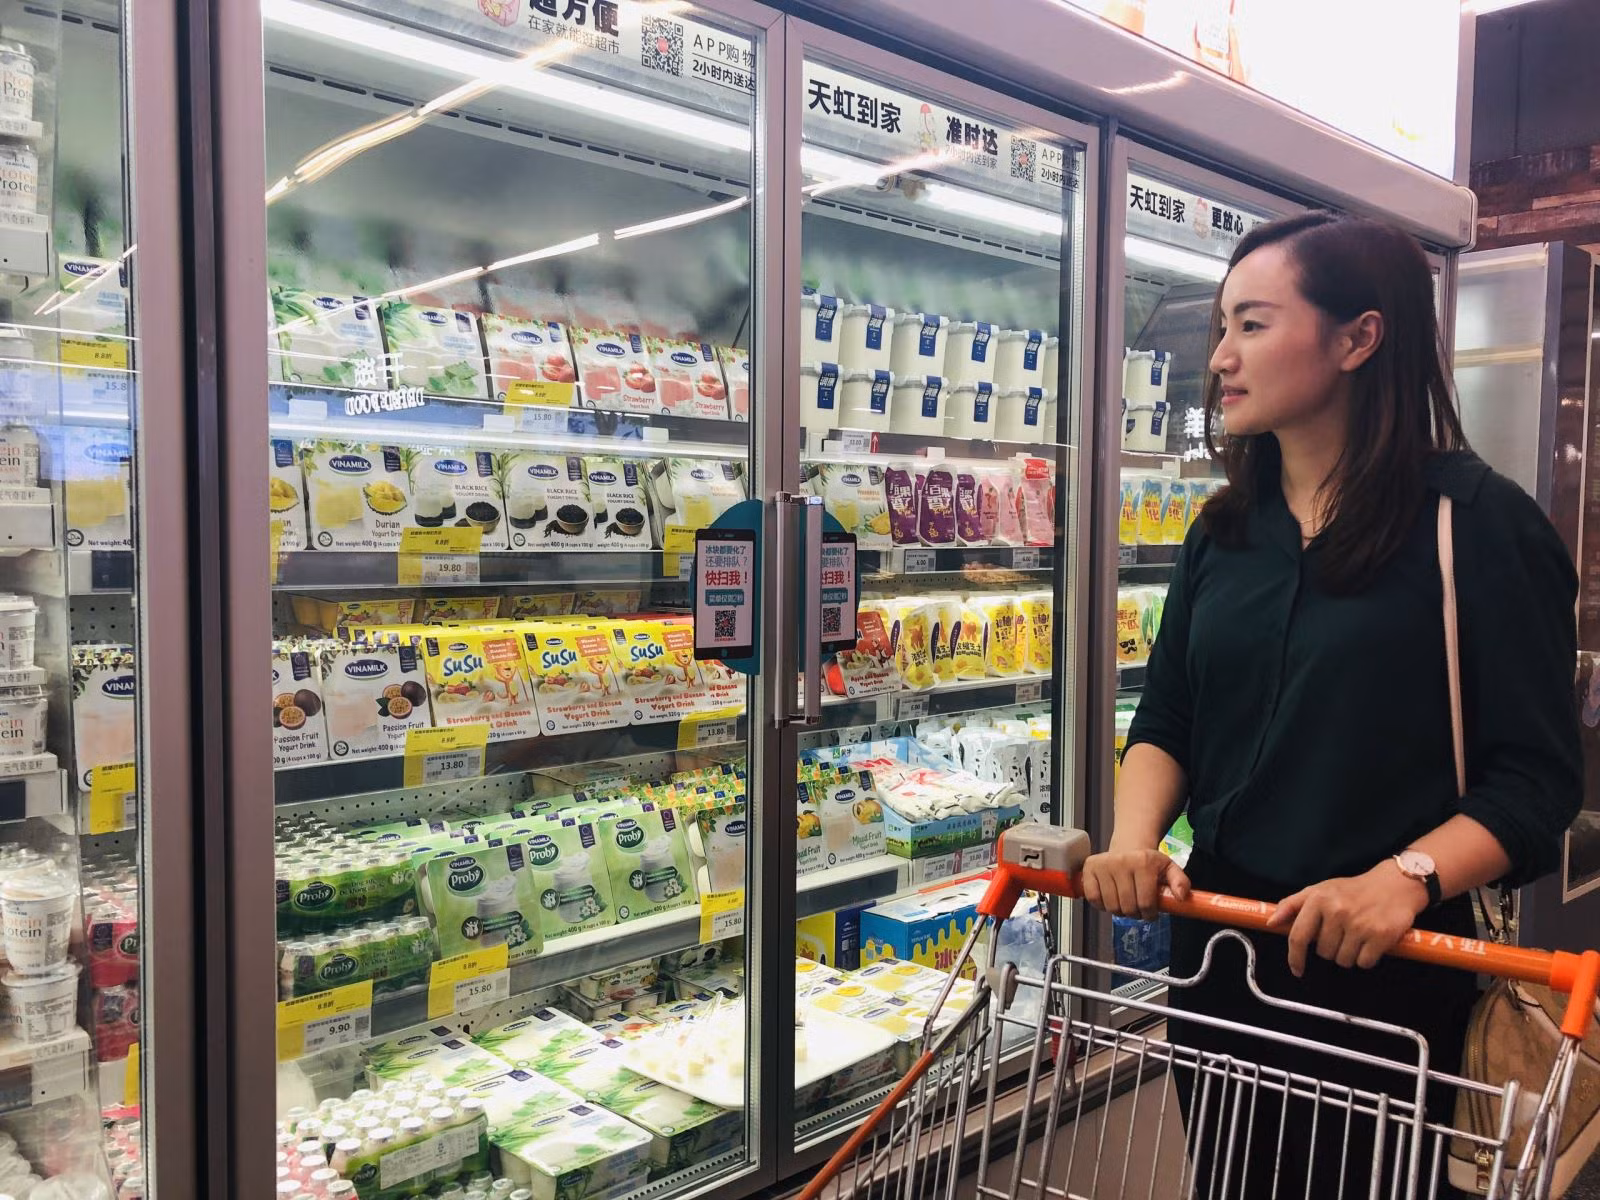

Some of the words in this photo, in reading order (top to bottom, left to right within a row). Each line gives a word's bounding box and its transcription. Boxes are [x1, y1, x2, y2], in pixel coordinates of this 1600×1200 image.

[692, 59, 757, 91] 2小时内送达
[808, 78, 901, 133] 天虹到家
[946, 115, 998, 156] 准时达
[1129, 184, 1185, 224] 天虹到家
[1211, 206, 1244, 236] 更放心
[511, 331, 542, 345] VINAMILK
[597, 345, 625, 356] VINAMILK
[672, 354, 697, 365] VINAMILK
[623, 393, 655, 405] Strawberry
[695, 400, 725, 411] Strawberry
[534, 413, 552, 421] 15.80
[331, 459, 370, 470] VINAMILK
[435, 462, 467, 473] VINAMILK
[529, 467, 558, 478] VINAMILK
[590, 473, 617, 483] VINAMILK
[375, 519, 400, 529] Durian
[372, 530, 389, 538] Yogurt
[705, 545, 747, 555] 冰块都要化了
[439, 563, 462, 572] 19.80
[704, 569, 748, 586] 快扫我！
[542, 648, 577, 669] SuSu
[630, 643, 664, 662] SuSu
[346, 663, 386, 674] VINAMILK
[443, 654, 483, 677] SuSu
[634, 695, 672, 705] Strawberry
[684, 691, 706, 699] Banana
[546, 703, 586, 714] Strawberry
[598, 700, 622, 708] Banana
[651, 702, 675, 712] Yogurt
[446, 714, 490, 725] Strawberry
[504, 709, 532, 718] Banana
[564, 710, 590, 721] Yogurt
[590, 709, 611, 717] Drink
[383, 723, 407, 733] Passion
[408, 721, 425, 730] Fruit
[495, 719, 518, 728] Drink
[273, 734, 300, 745] Passion
[301, 732, 319, 741] Fruit
[707, 729, 724, 737] 13.80
[278, 744, 299, 753] Yogurt
[299, 741, 316, 750] Drink
[441, 760, 464, 771] 13.80
[615, 820, 638, 830] VINAMILK
[528, 836, 552, 846] VINAMILK
[617, 829, 643, 846] Proby
[868, 831, 882, 839] Fruit
[529, 846, 557, 866] Proby
[449, 859, 476, 870] VINAMILK
[451, 869, 483, 887] Proby
[299, 889, 330, 903] Proby
[725, 917, 742, 928] 15.80
[324, 961, 353, 976] Proby
[469, 983, 492, 996] 15.80
[329, 1022, 351, 1036] 9.90
